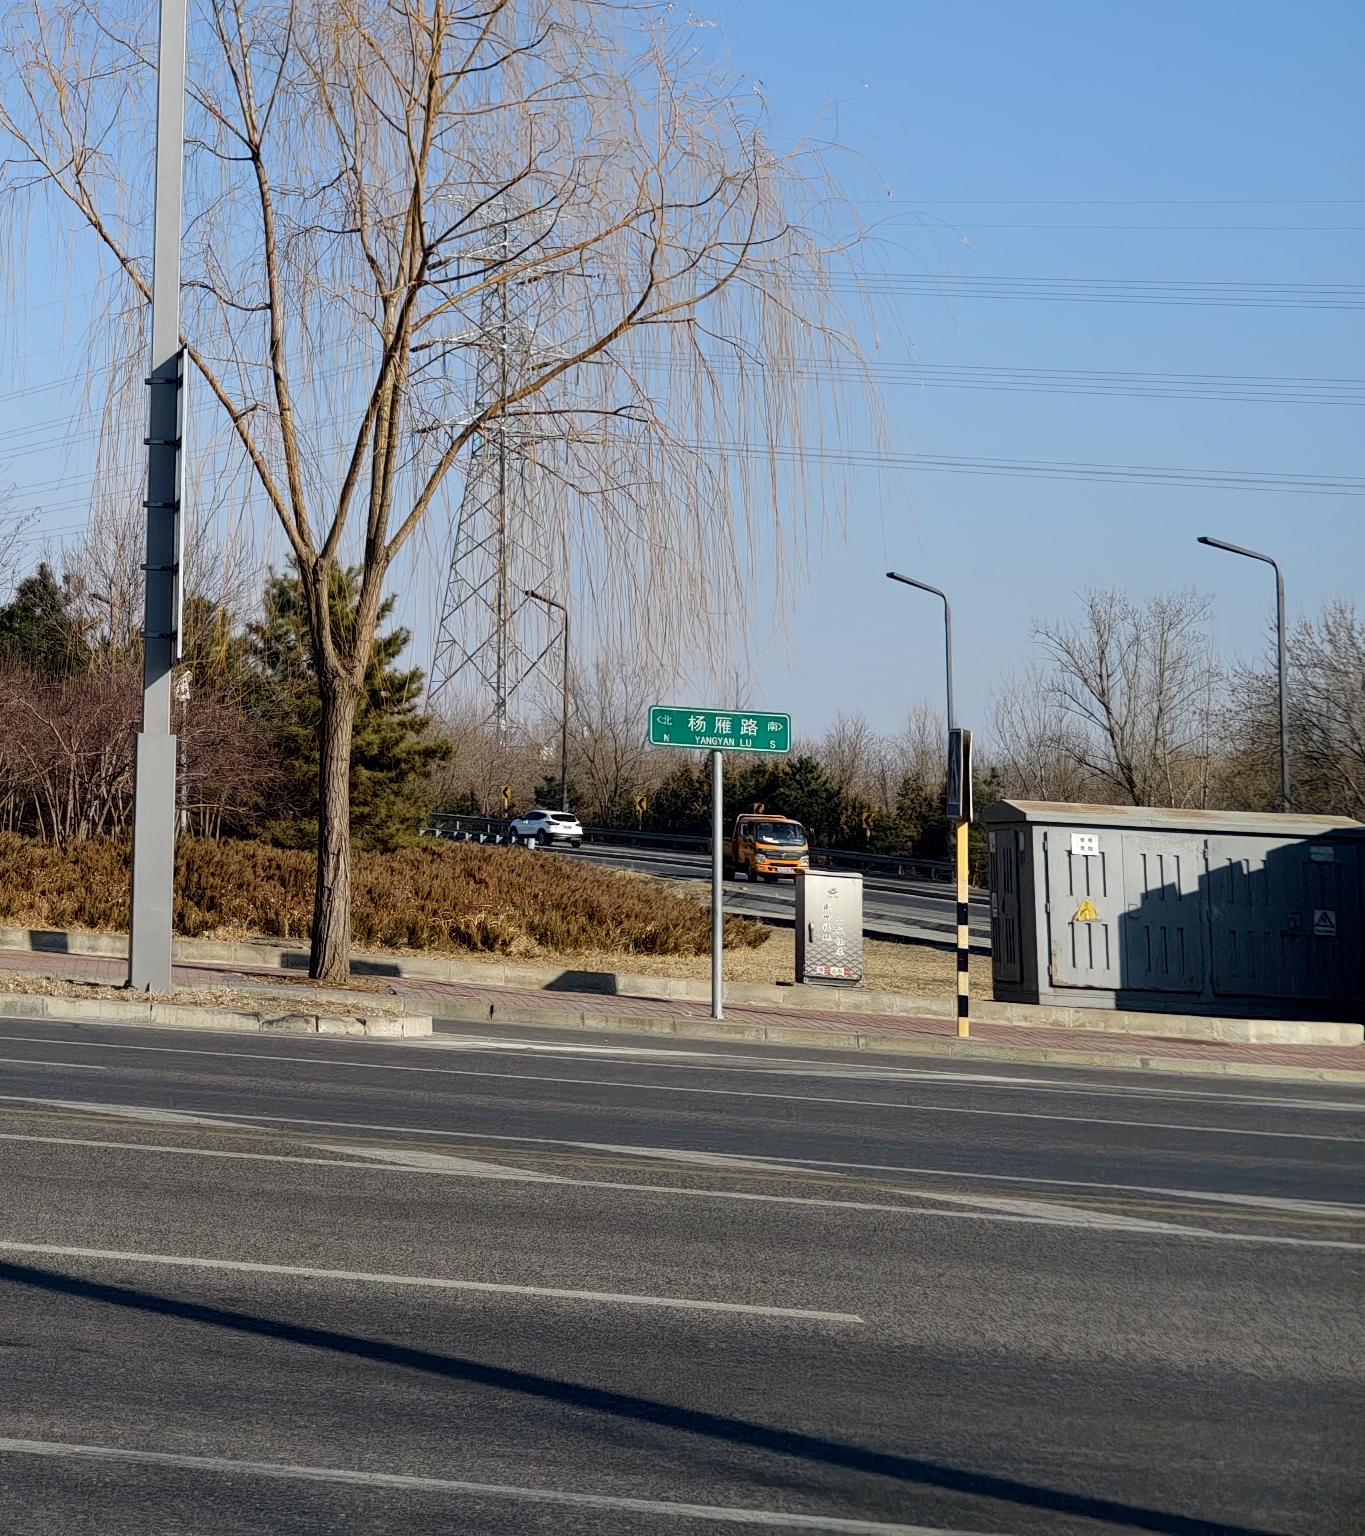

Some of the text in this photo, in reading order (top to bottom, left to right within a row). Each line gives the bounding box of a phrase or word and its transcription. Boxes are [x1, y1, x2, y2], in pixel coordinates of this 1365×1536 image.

[661, 714, 778, 736] 北 杨雁路 南
[663, 733, 776, 749] N YANGYAN LU S
